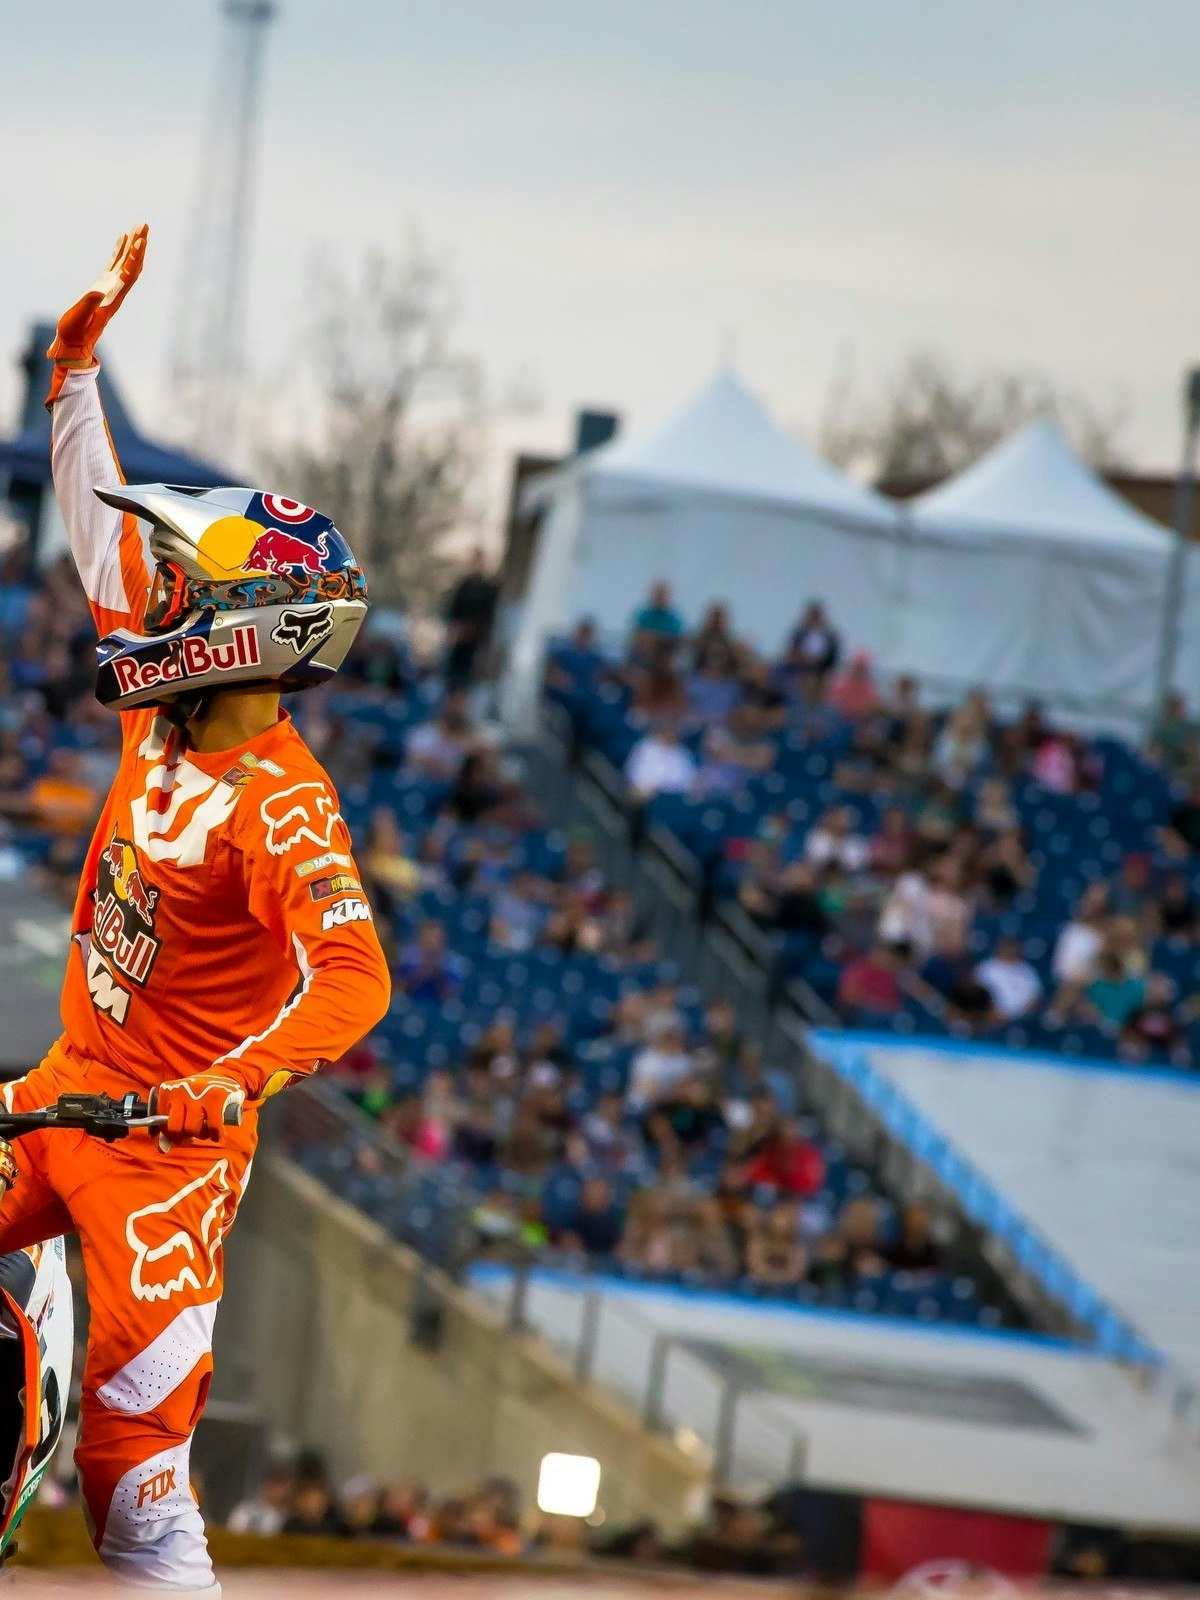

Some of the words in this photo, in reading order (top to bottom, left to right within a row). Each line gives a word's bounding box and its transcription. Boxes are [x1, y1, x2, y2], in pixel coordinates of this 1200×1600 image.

[112, 638, 184, 697] Red
[183, 624, 262, 677] Bull
[100, 904, 158, 984] Bull
[322, 898, 373, 931] KTM
[137, 1464, 177, 1509] FOX
